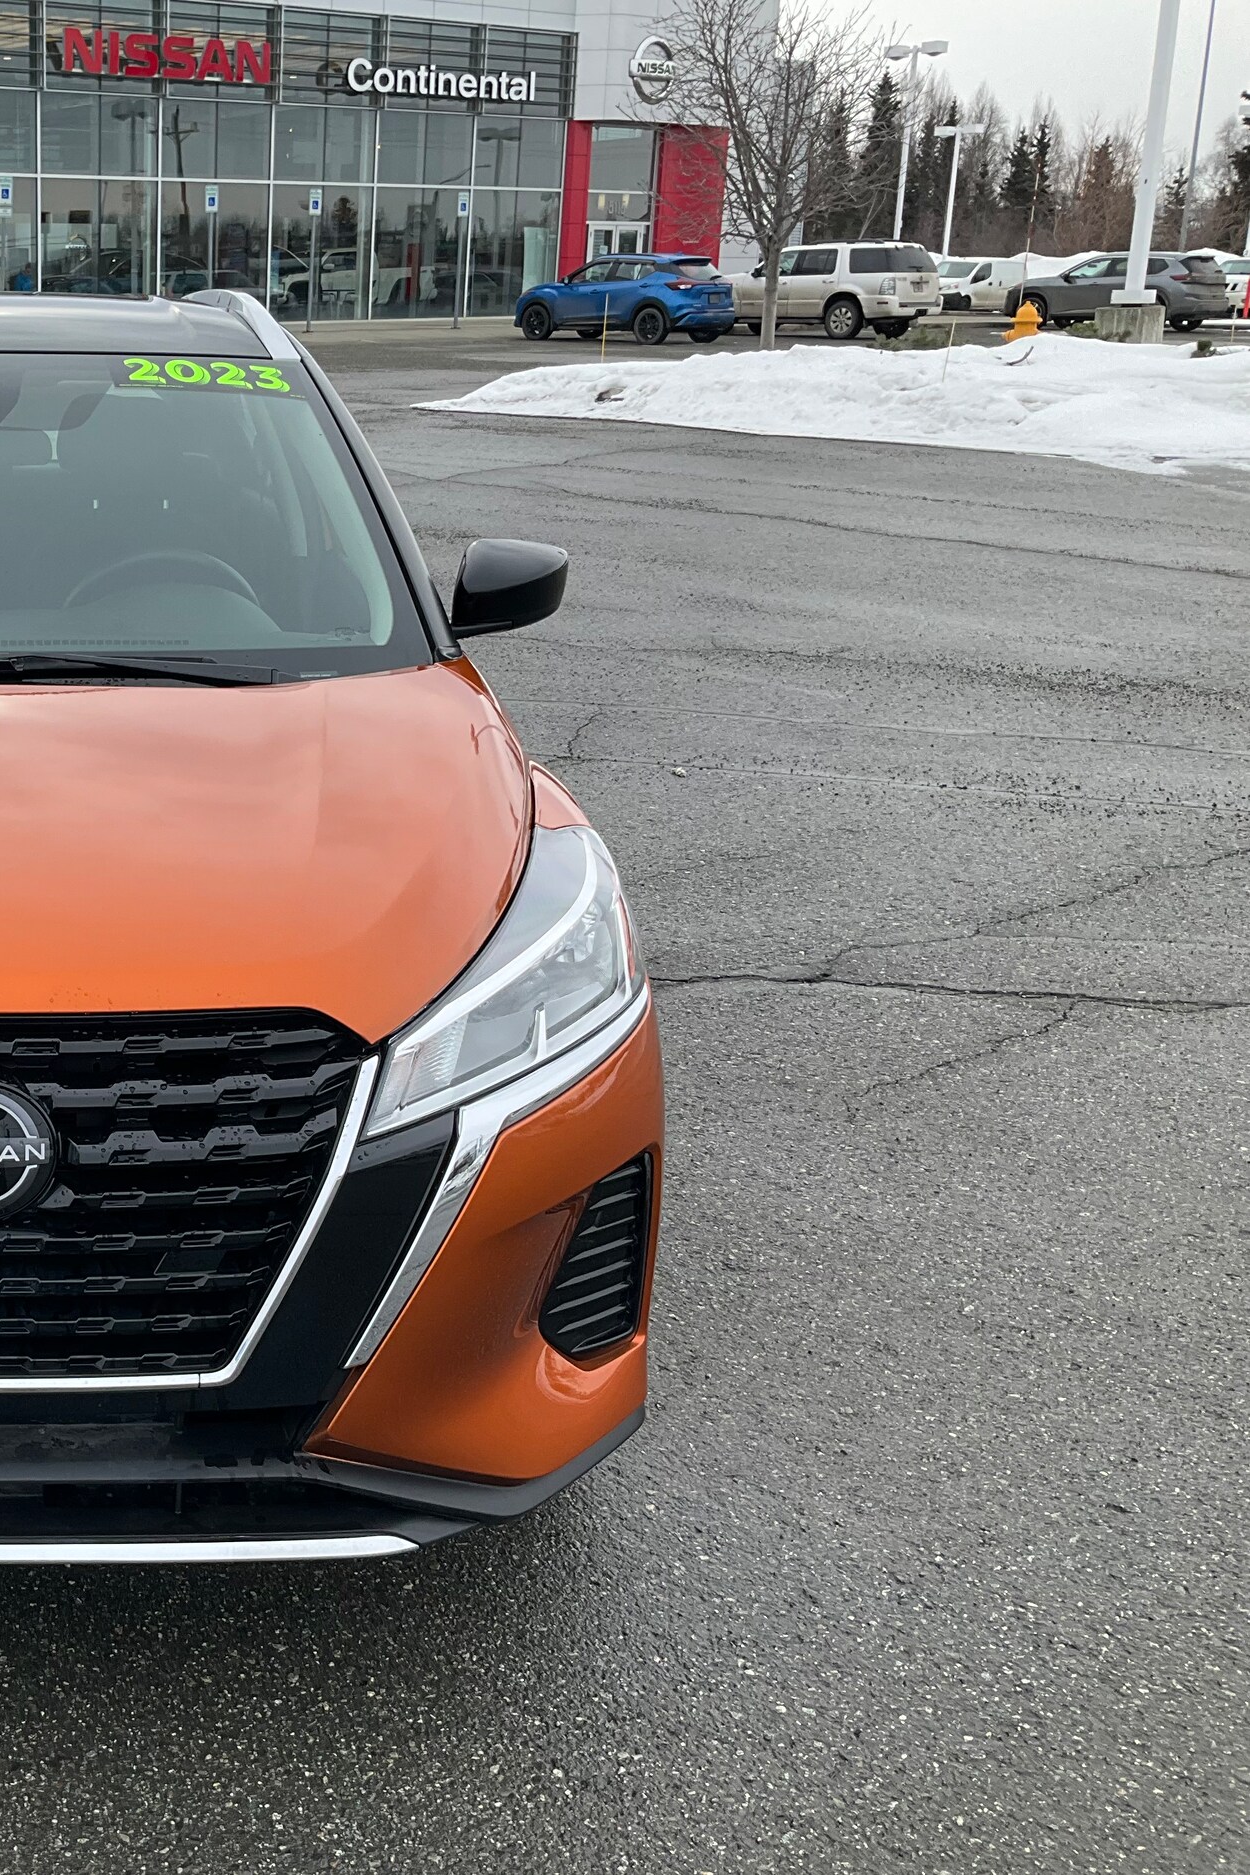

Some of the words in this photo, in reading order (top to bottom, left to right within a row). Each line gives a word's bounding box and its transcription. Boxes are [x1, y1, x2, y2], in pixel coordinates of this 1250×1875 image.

[63, 27, 270, 83] NISSAN
[347, 57, 536, 101] Continental
[123, 357, 291, 393] 2023
